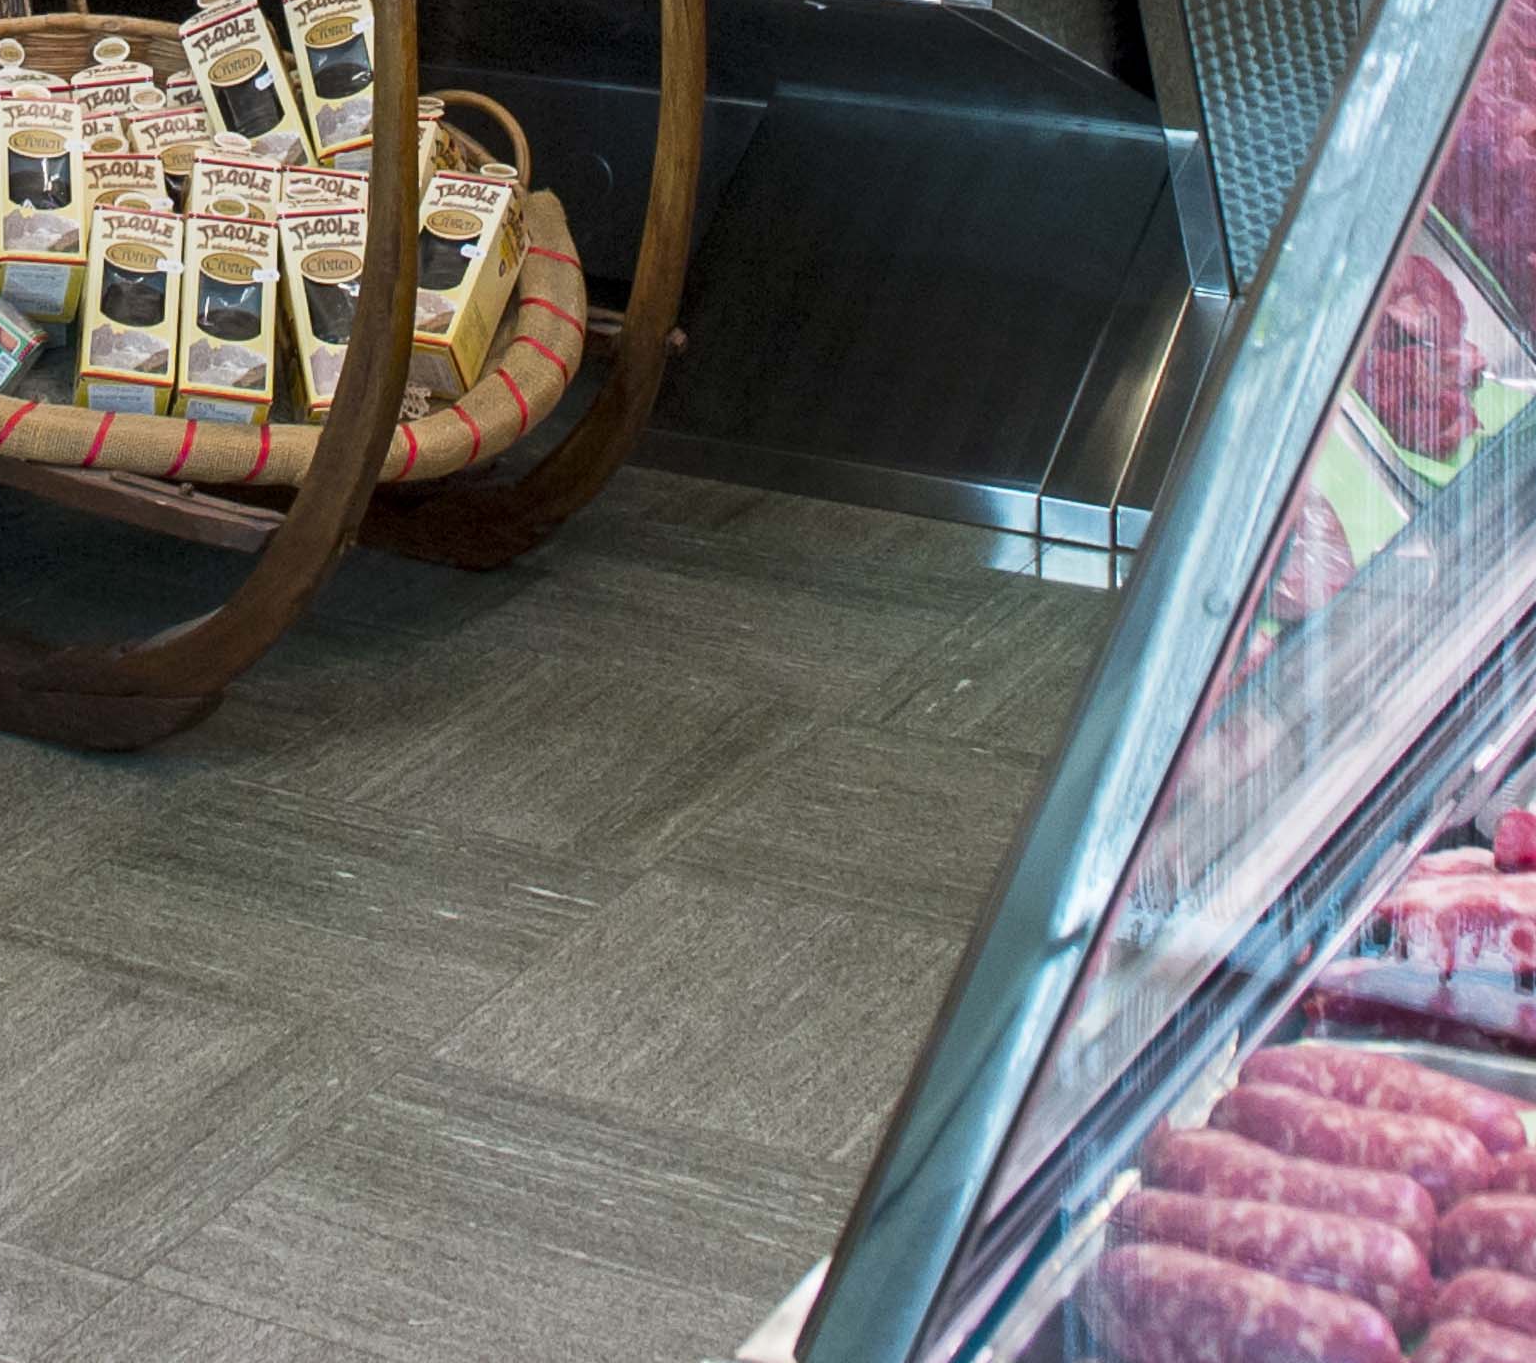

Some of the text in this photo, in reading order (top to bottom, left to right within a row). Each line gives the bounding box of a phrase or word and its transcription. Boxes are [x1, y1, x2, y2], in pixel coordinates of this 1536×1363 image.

[192, 19, 256, 56] TEGOLE
[2, 104, 73, 125] TEGOLE
[86, 161, 156, 183] TEGOLE
[202, 168, 273, 193] TEGOLE
[435, 182, 500, 206] TEGOLE
[103, 215, 175, 238] TEGOLE
[198, 223, 270, 248] TEGOLE
[288, 217, 360, 245] TEGOLE
